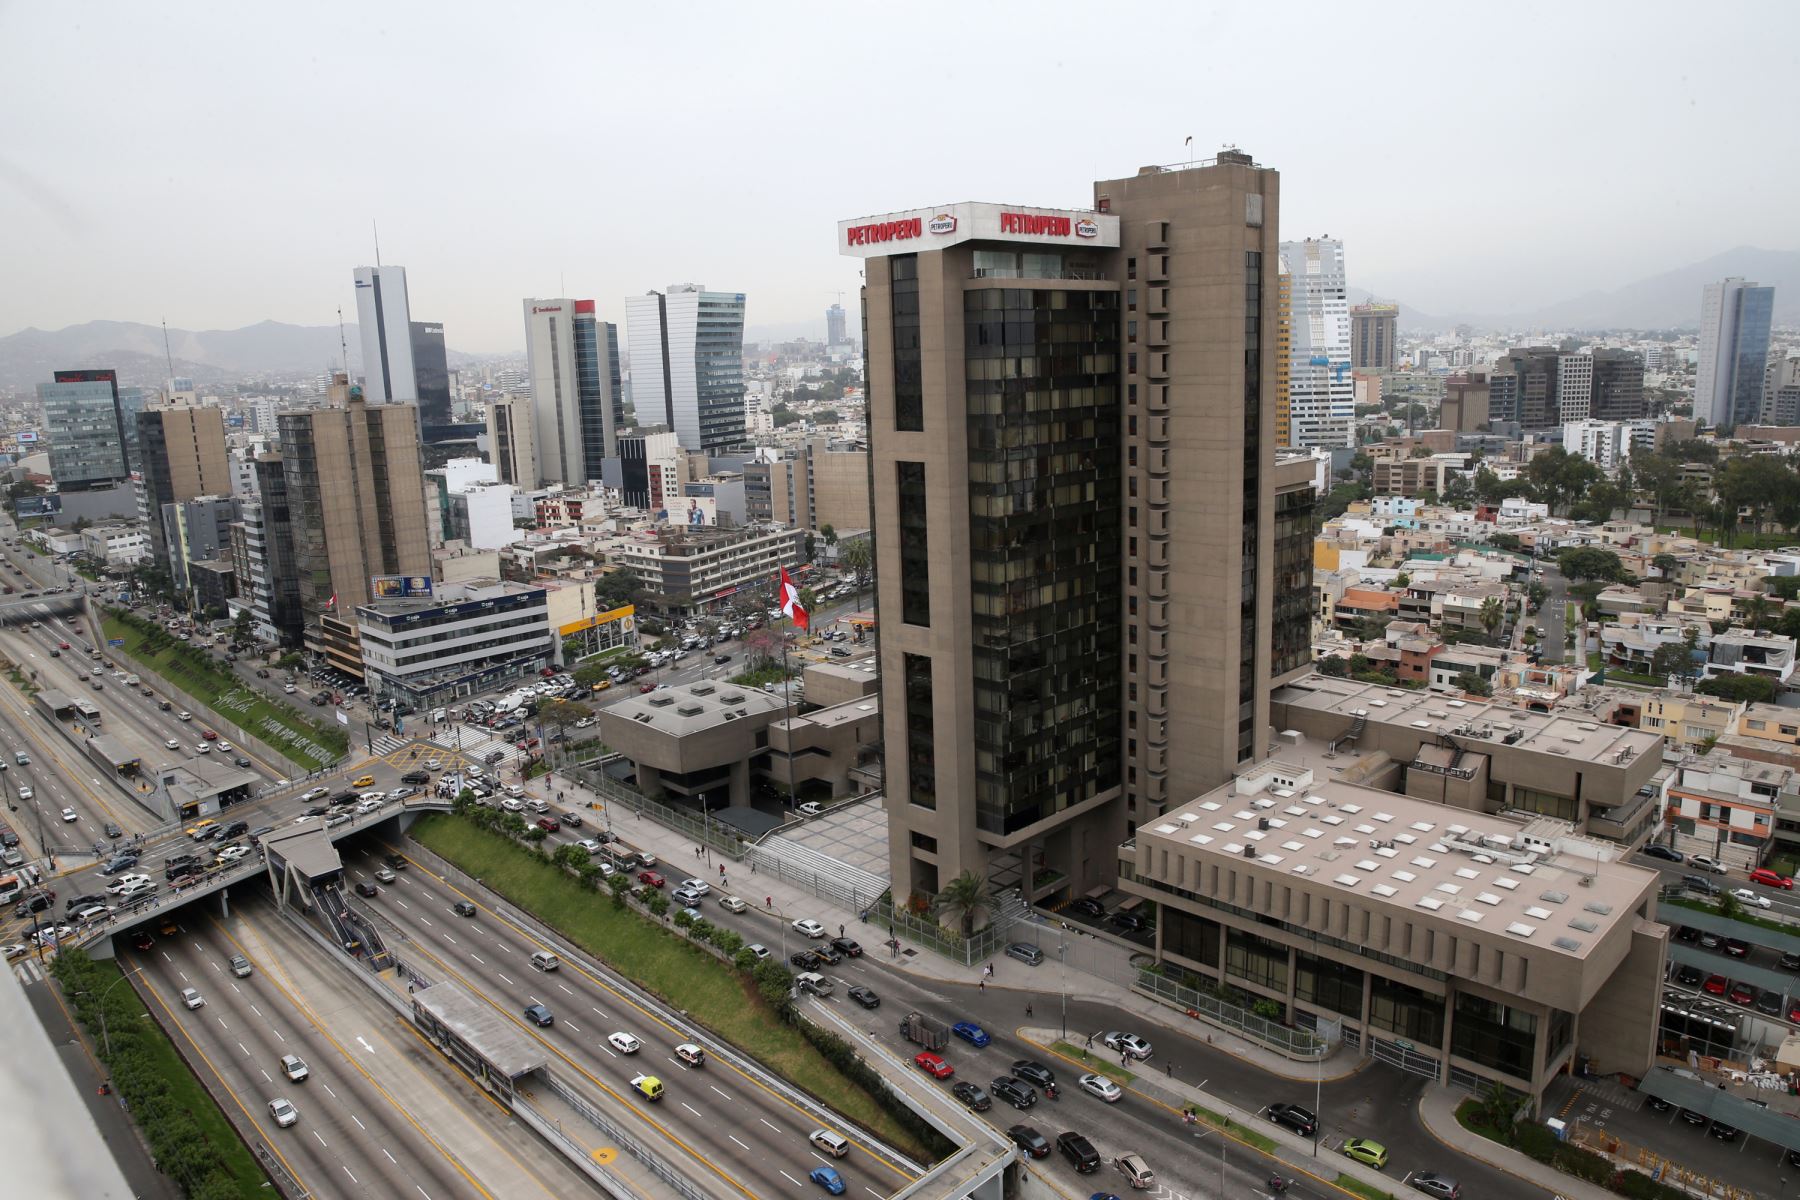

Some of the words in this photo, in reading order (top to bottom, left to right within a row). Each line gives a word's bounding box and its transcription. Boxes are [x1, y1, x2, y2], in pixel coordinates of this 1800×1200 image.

[847, 217, 922, 246] PETROPERU
[930, 222, 953, 231] PETROPERU
[1000, 212, 1070, 236] PETROPERU
